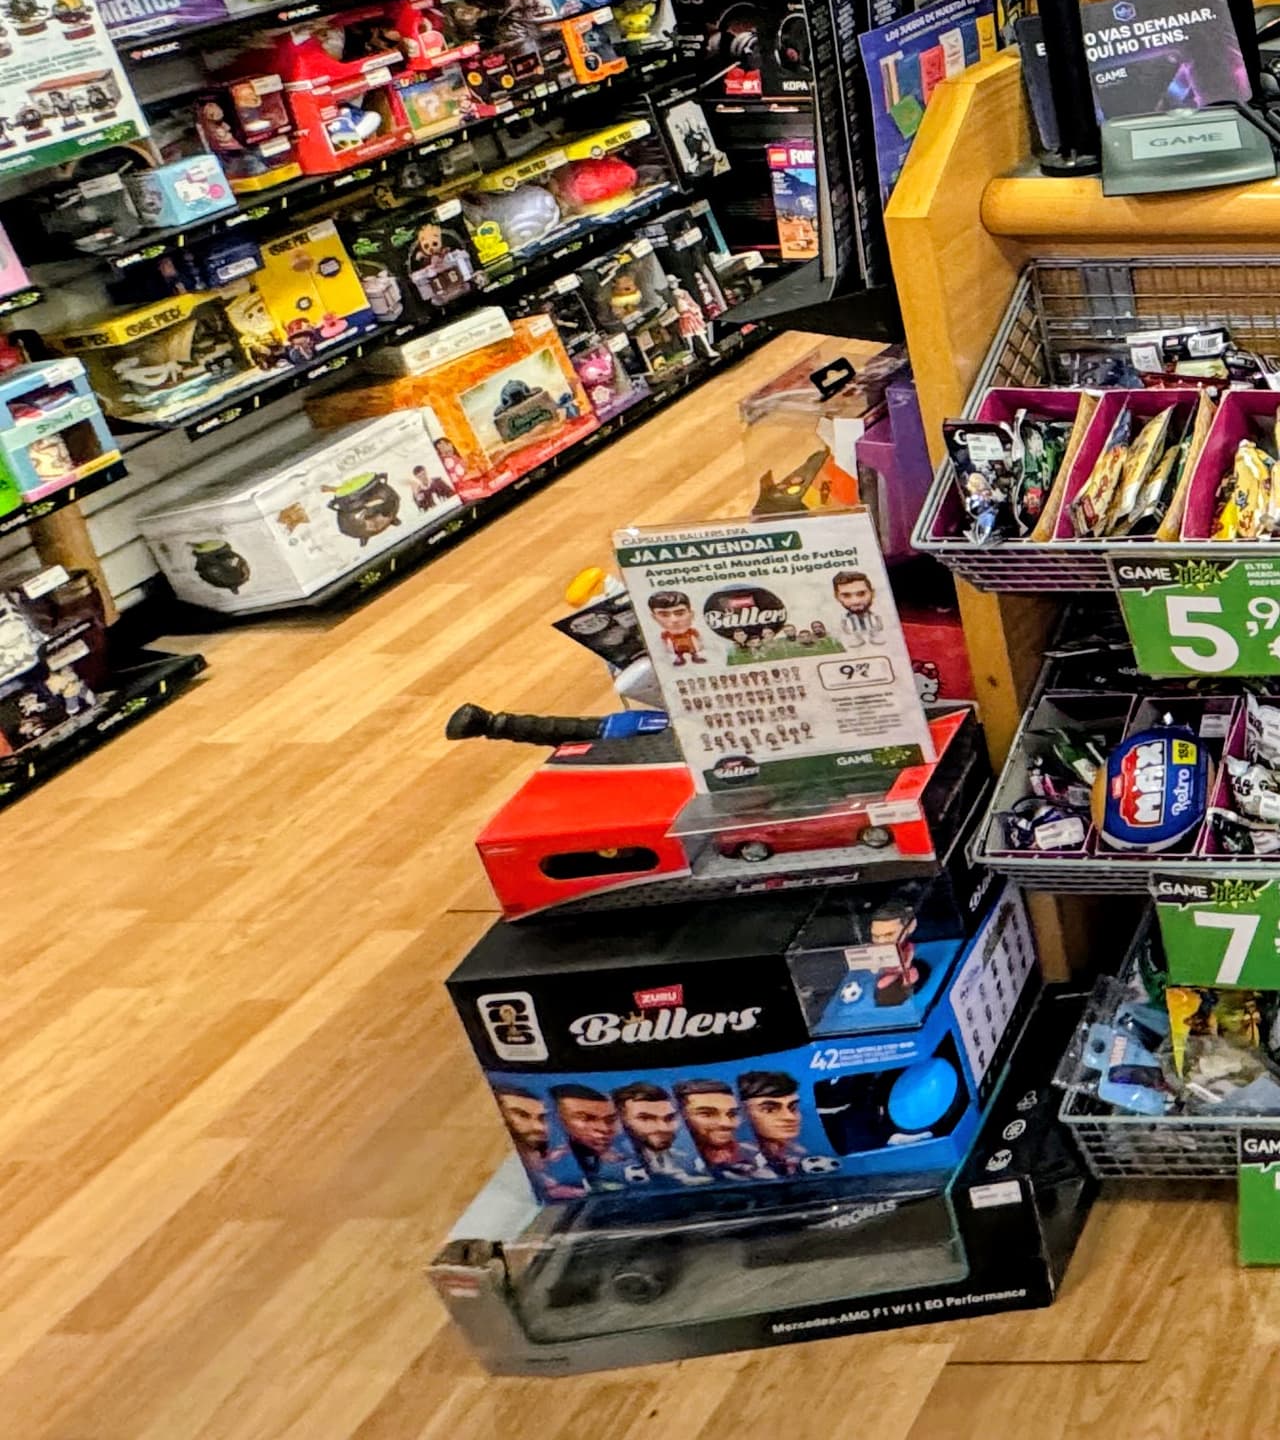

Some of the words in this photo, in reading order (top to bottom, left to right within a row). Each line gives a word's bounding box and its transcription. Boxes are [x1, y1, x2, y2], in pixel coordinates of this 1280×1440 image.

[1099, 27, 1131, 42] VAS
[1134, 9, 1217, 35] DEMANAR.
[1119, 39, 1139, 53] HO
[1144, 30, 1189, 48] TENS.
[1095, 67, 1127, 84] GAME
[1149, 131, 1223, 147] GAME
[629, 551, 656, 564] JA
[659, 550, 670, 560] A
[675, 548, 698, 560] LA
[703, 538, 774, 557] VENDA!
[714, 560, 727, 570] al
[730, 554, 788, 569] Mundial
[791, 552, 809, 562] de
[813, 547, 858, 561] Futbol
[1119, 565, 1171, 581] GAME
[1165, 595, 1239, 673] 5
[1172, 769, 1189, 816] Retro
[1158, 882, 1207, 898] GAME
[1192, 911, 1261, 984] 7
[640, 991, 677, 1003] ZURU
[569, 1005, 762, 1047] Ballers
[809, 1050, 839, 1071] 42
[772, 1310, 870, 1333] Mercedes-AMG
[946, 1288, 1026, 1307] Performance
